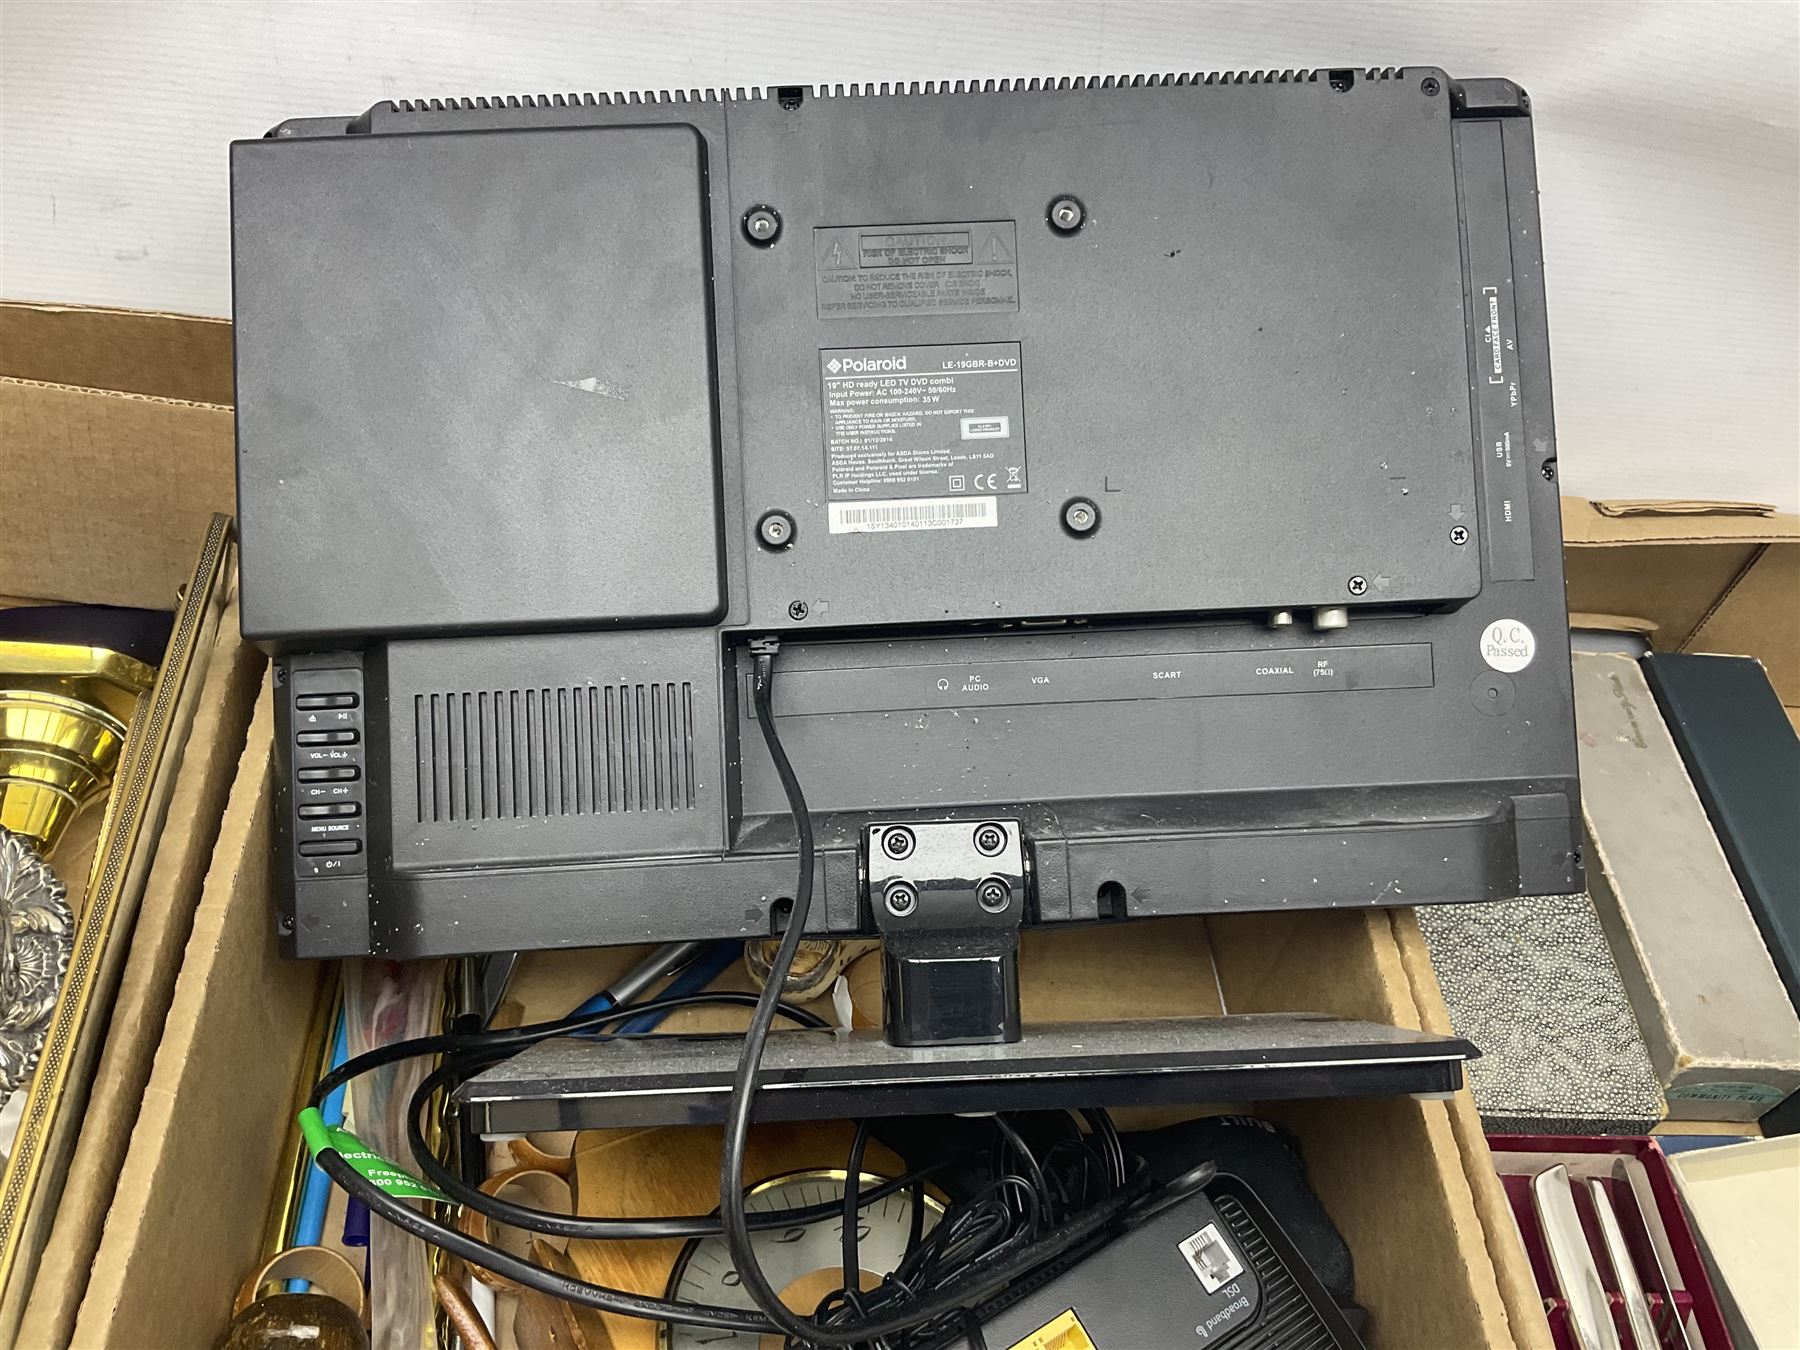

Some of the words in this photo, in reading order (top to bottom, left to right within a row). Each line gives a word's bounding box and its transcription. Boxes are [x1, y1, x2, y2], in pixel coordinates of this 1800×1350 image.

[1485, 334, 1492, 342] CI
[1506, 339, 1514, 350] AV
[842, 356, 906, 372] Polaroid
[942, 358, 1017, 369] LE-19GBR-B+DVD
[856, 380, 878, 389] ready
[930, 376, 954, 385] combi
[828, 391, 848, 399] Input
[849, 390, 875, 398] Power:
[1510, 382, 1518, 408] YPbPr
[846, 399, 869, 408] power
[870, 396, 920, 406] consumption:
[1486, 644, 1528, 657] Passed
[1317, 660, 1328, 669] RF
[1152, 670, 1182, 680] SCART
[1255, 666, 1294, 677] COAXIAL
[969, 675, 982, 683] PC
[1031, 676, 1050, 684] VGA
[962, 683, 990, 692] AUDIO
[1220, 1115, 1276, 1133] BUILT
[1222, 1283, 1240, 1298] DSL
[1206, 1296, 1250, 1331] Broadband
